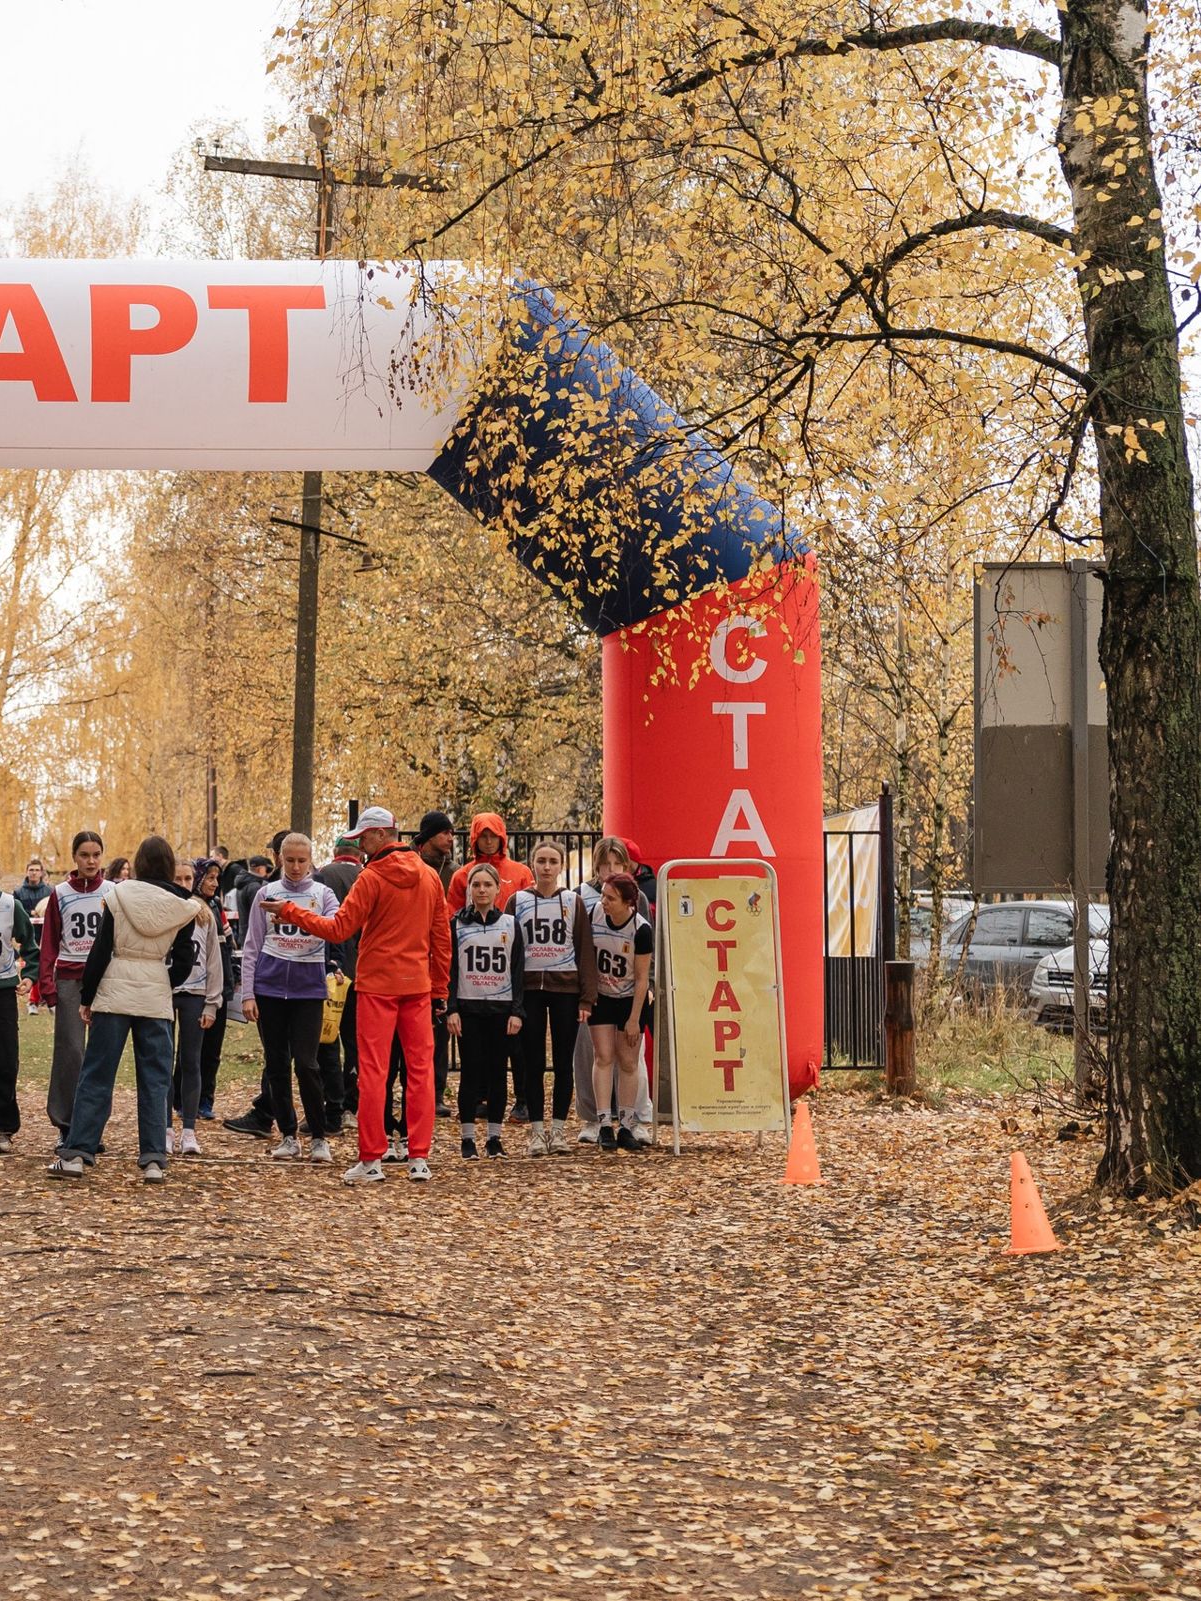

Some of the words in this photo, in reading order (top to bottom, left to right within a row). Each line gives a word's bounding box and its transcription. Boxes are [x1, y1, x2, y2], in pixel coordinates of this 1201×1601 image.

[709, 614, 777, 879] СТА
[70, 911, 102, 939] 39
[523, 918, 567, 945] 158
[463, 945, 507, 973] 155
[705, 899, 744, 1092] СТАРТ
